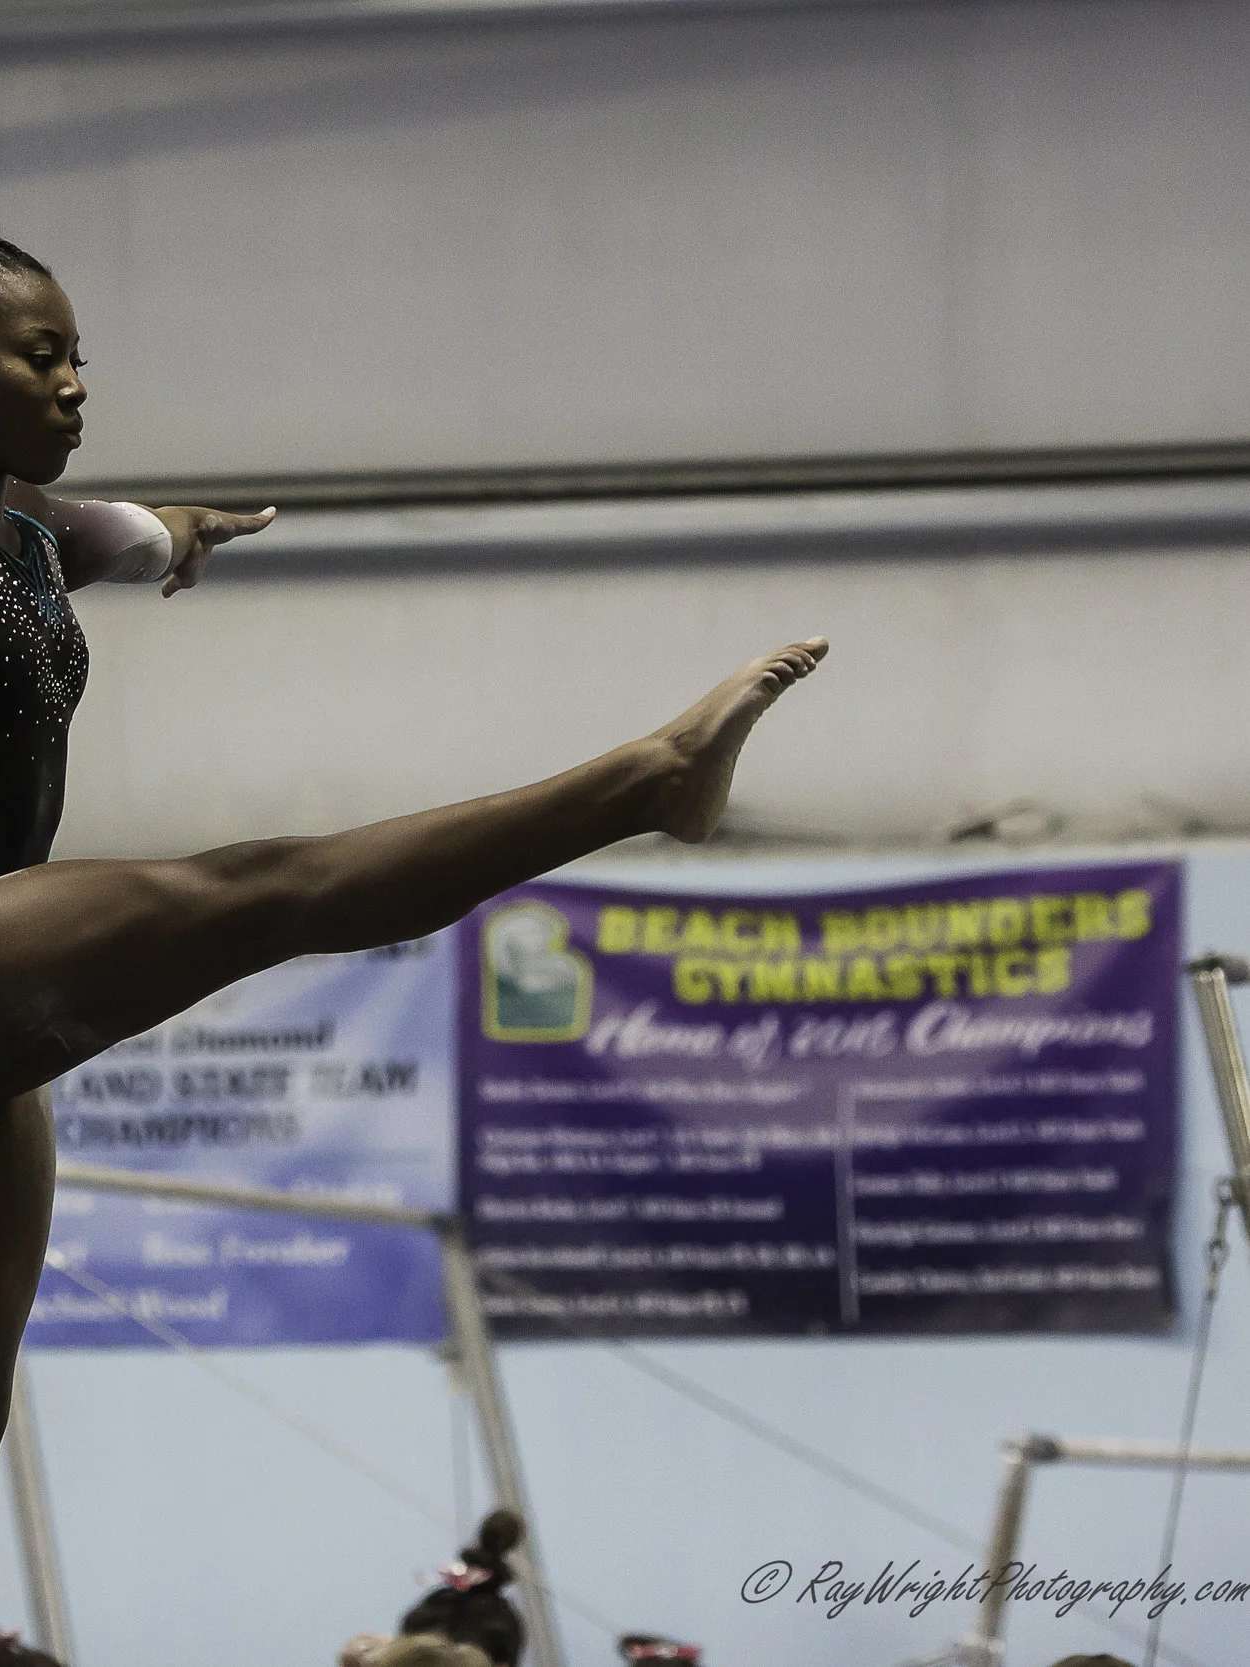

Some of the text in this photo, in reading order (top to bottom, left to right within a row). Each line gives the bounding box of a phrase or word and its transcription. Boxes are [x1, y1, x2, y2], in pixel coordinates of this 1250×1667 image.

[597, 889, 1151, 957] BEACH BOUNDERS
[673, 948, 1071, 1004] GYMNASTICS
[585, 1006, 724, 1057] Home
[727, 1013, 781, 1069] of
[903, 1001, 1151, 1059] Champions
[57, 1065, 163, 1104] LAND
